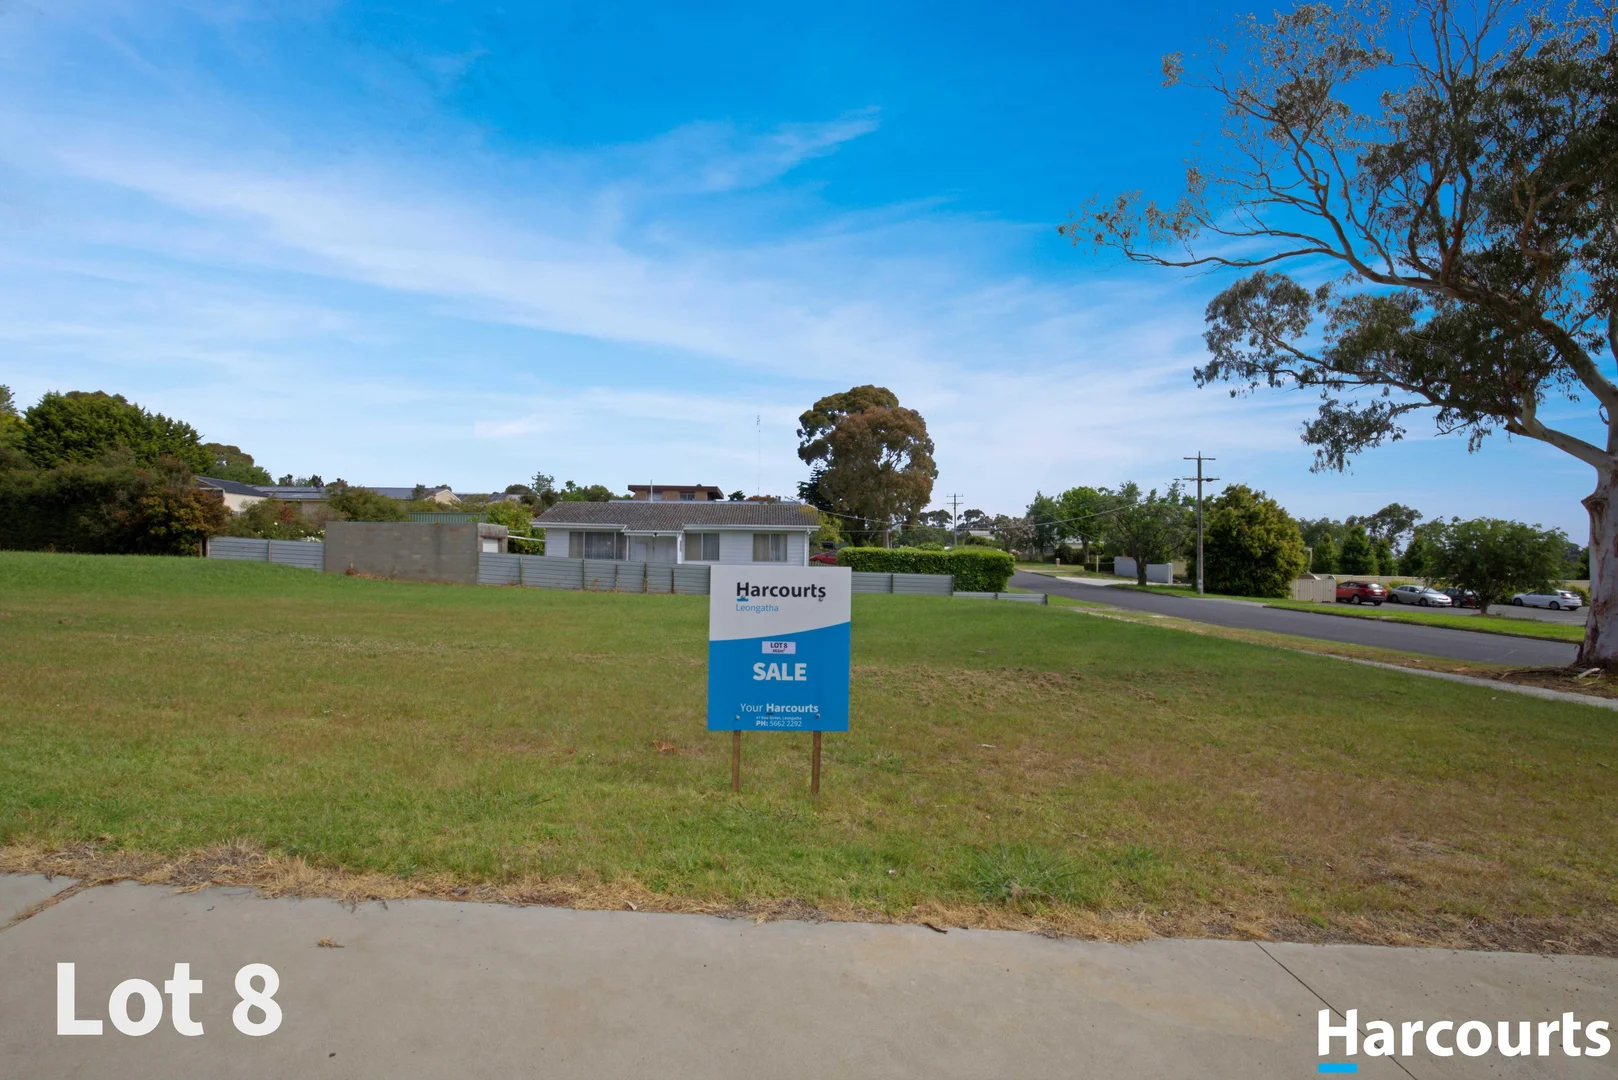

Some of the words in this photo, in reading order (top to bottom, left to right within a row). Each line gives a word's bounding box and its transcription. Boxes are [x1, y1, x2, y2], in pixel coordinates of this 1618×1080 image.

[736, 582, 826, 598] Harcourts
[736, 603, 779, 613] Leongatha
[752, 662, 807, 681] SALE
[740, 703, 763, 712] Your
[766, 703, 819, 713] Harcourts
